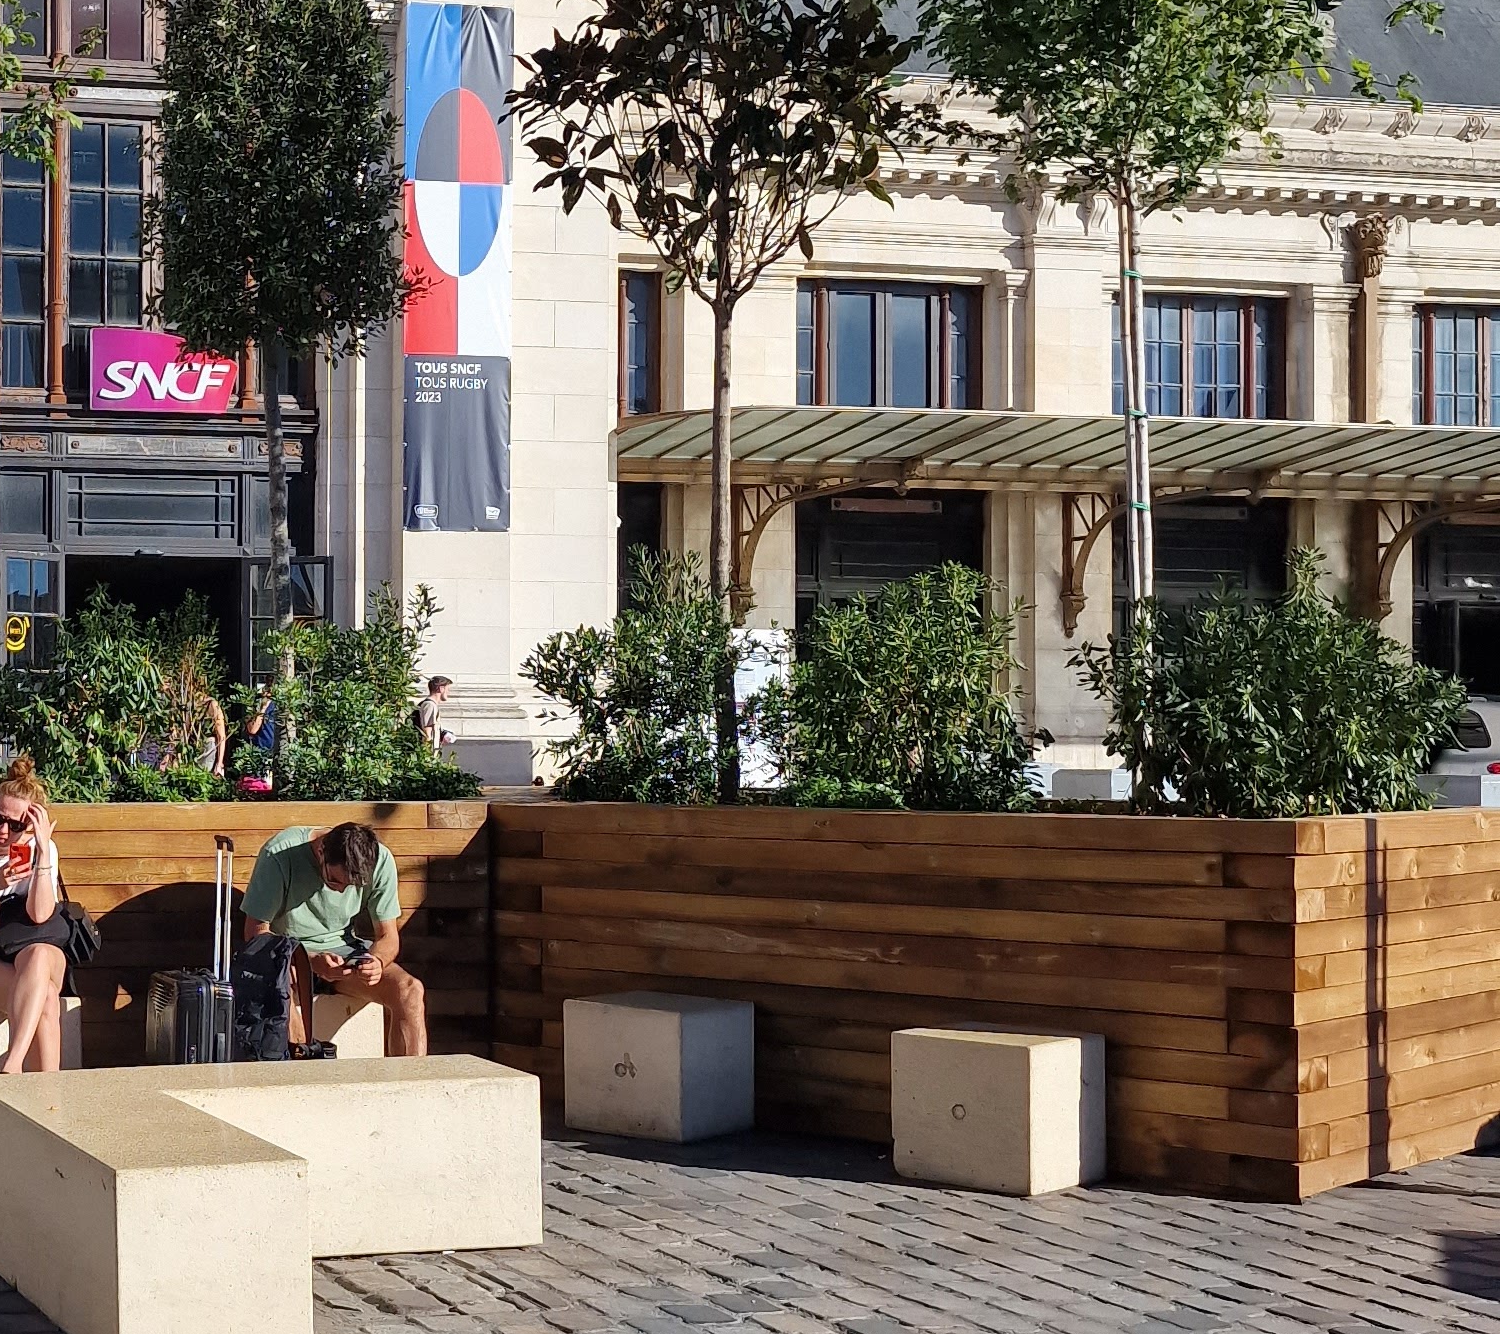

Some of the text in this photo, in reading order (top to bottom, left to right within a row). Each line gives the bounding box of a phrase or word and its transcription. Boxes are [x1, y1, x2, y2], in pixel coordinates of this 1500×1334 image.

[414, 362, 482, 375] TOUS SNCF
[100, 360, 231, 402] SNCF
[414, 376, 489, 390] TOUS RUGBY
[414, 391, 442, 403] 2023
